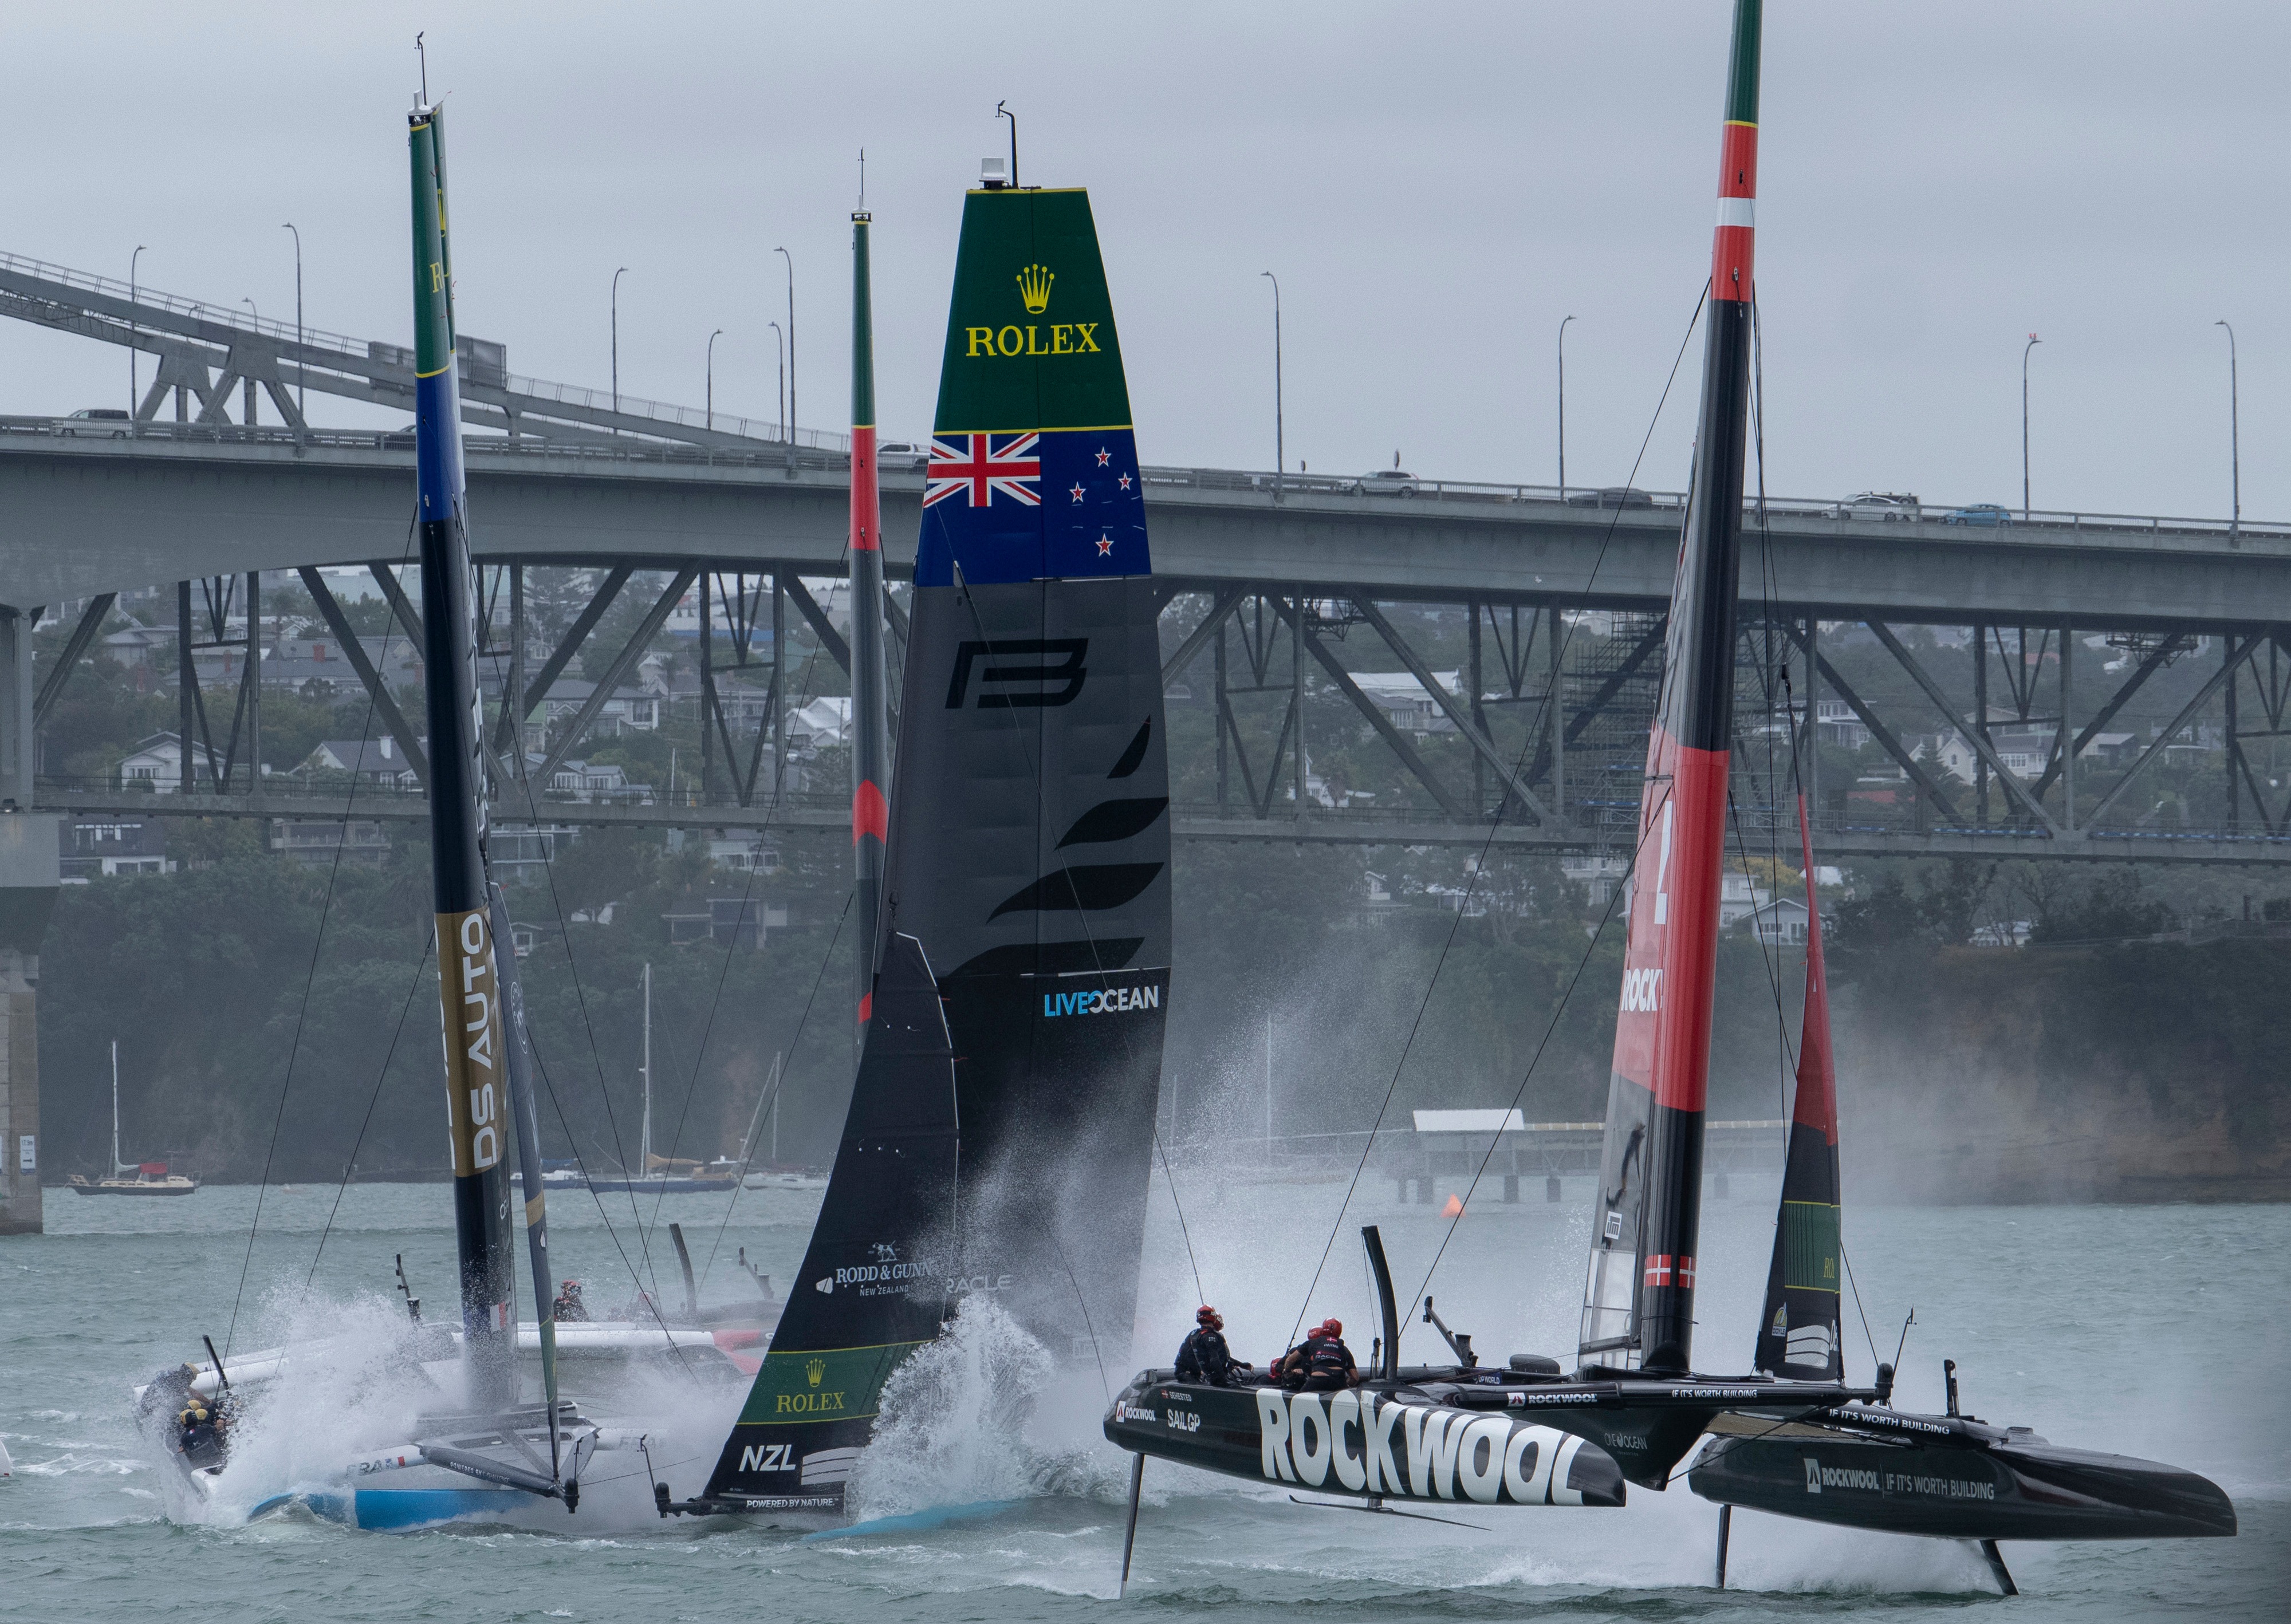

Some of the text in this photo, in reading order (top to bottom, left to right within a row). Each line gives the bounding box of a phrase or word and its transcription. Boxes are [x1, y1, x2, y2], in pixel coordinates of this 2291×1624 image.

[965, 323, 1101, 357] ROLEX
[1621, 968, 1663, 1012] ROCK
[461, 913, 497, 1169] DS AUTO
[836, 1262, 932, 1284] RODD & GUNN
[860, 1285, 908, 1296] NEW ZEALAND
[946, 1275, 1013, 1294] RACLE
[1485, 1376, 1500, 1384] WORLD
[776, 1392, 845, 1413] ROLEX
[1169, 1392, 1192, 1402] SEHESTED
[1529, 1393, 1597, 1404] ROCKWOOL
[1672, 1390, 1757, 1398] IF IT'S WORTH BUILDING
[1125, 1406, 1156, 1421] ROCKWOOL
[1829, 1408, 1950, 1434] IF IT'S WORTH BUILDING
[1255, 1388, 1585, 1507] ROCKWOOL
[1604, 1433, 1648, 1449] ONE OCEAN
[739, 1444, 796, 1472] NZL
[1822, 1467, 1994, 1500] ROCKWOOL IF IT'S WORTH BUILDING
[746, 1500, 788, 1508] POWERED
[789, 1499, 800, 1508] BY
